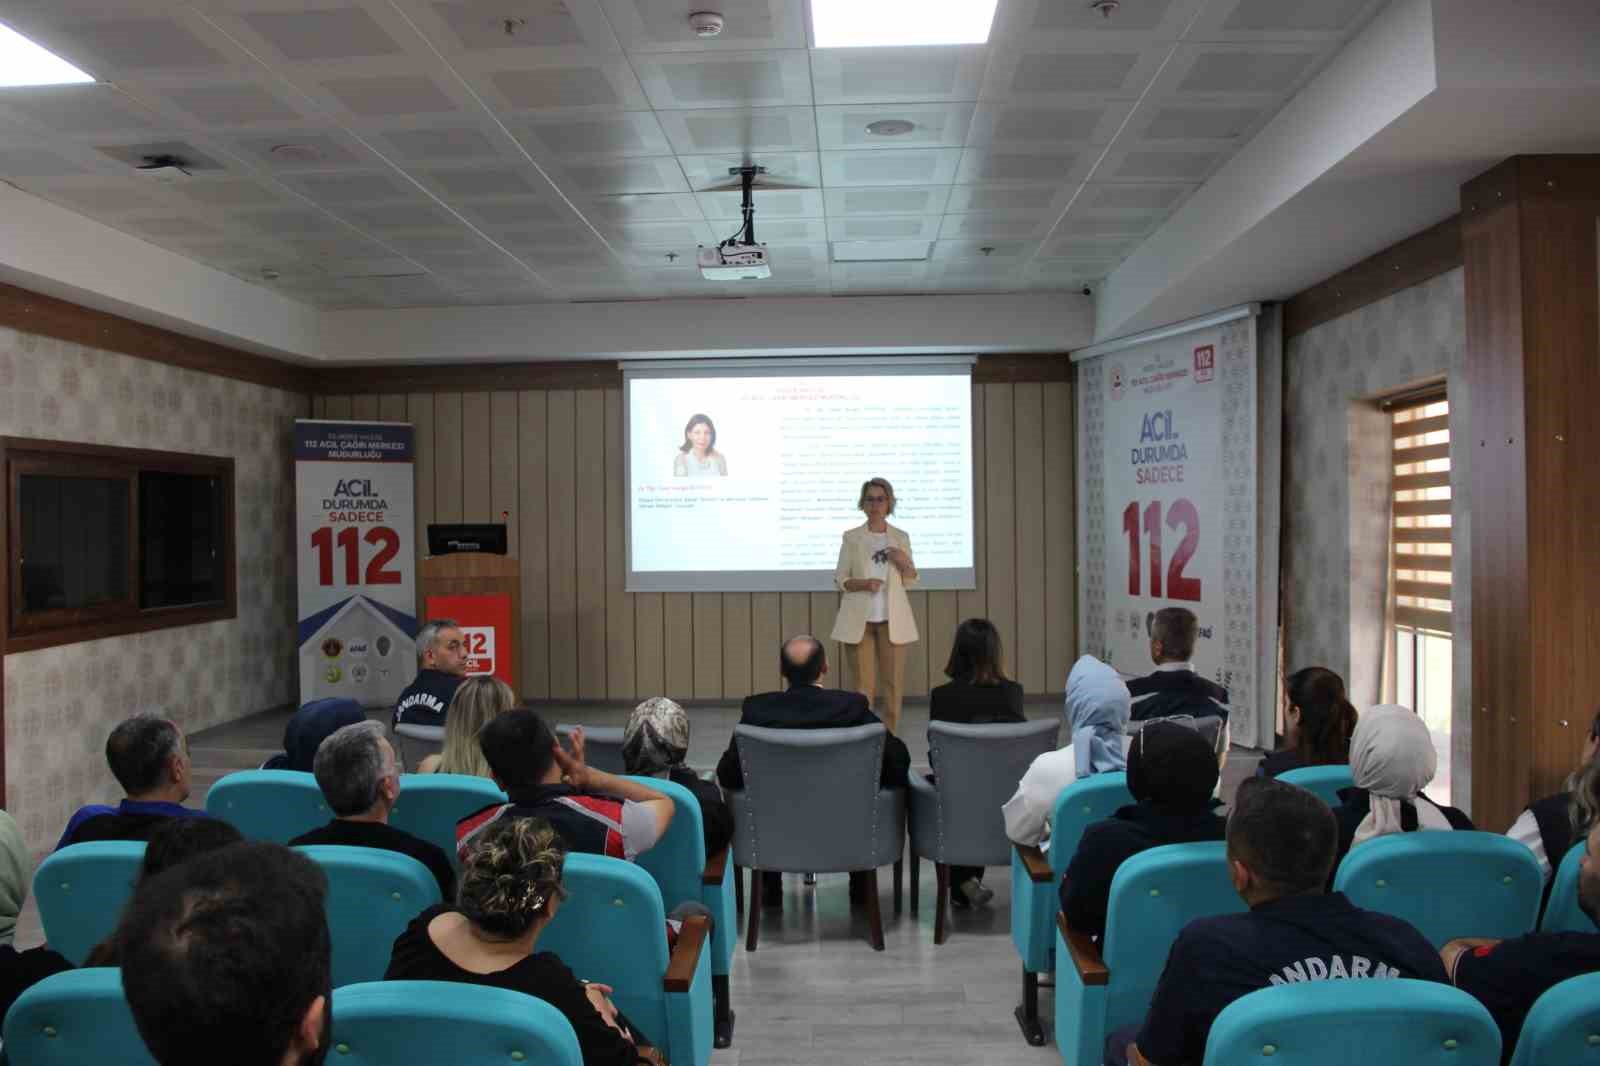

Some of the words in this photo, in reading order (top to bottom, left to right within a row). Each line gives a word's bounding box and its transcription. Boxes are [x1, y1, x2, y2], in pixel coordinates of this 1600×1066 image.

[1197, 350, 1212, 369] 112
[1131, 443, 1188, 465] DURUMDA
[1136, 464, 1184, 485] SADECE
[323, 499, 388, 510] DURUMDA
[329, 511, 384, 522] SADECE
[311, 526, 402, 586] 112
[1122, 498, 1201, 602] 112
